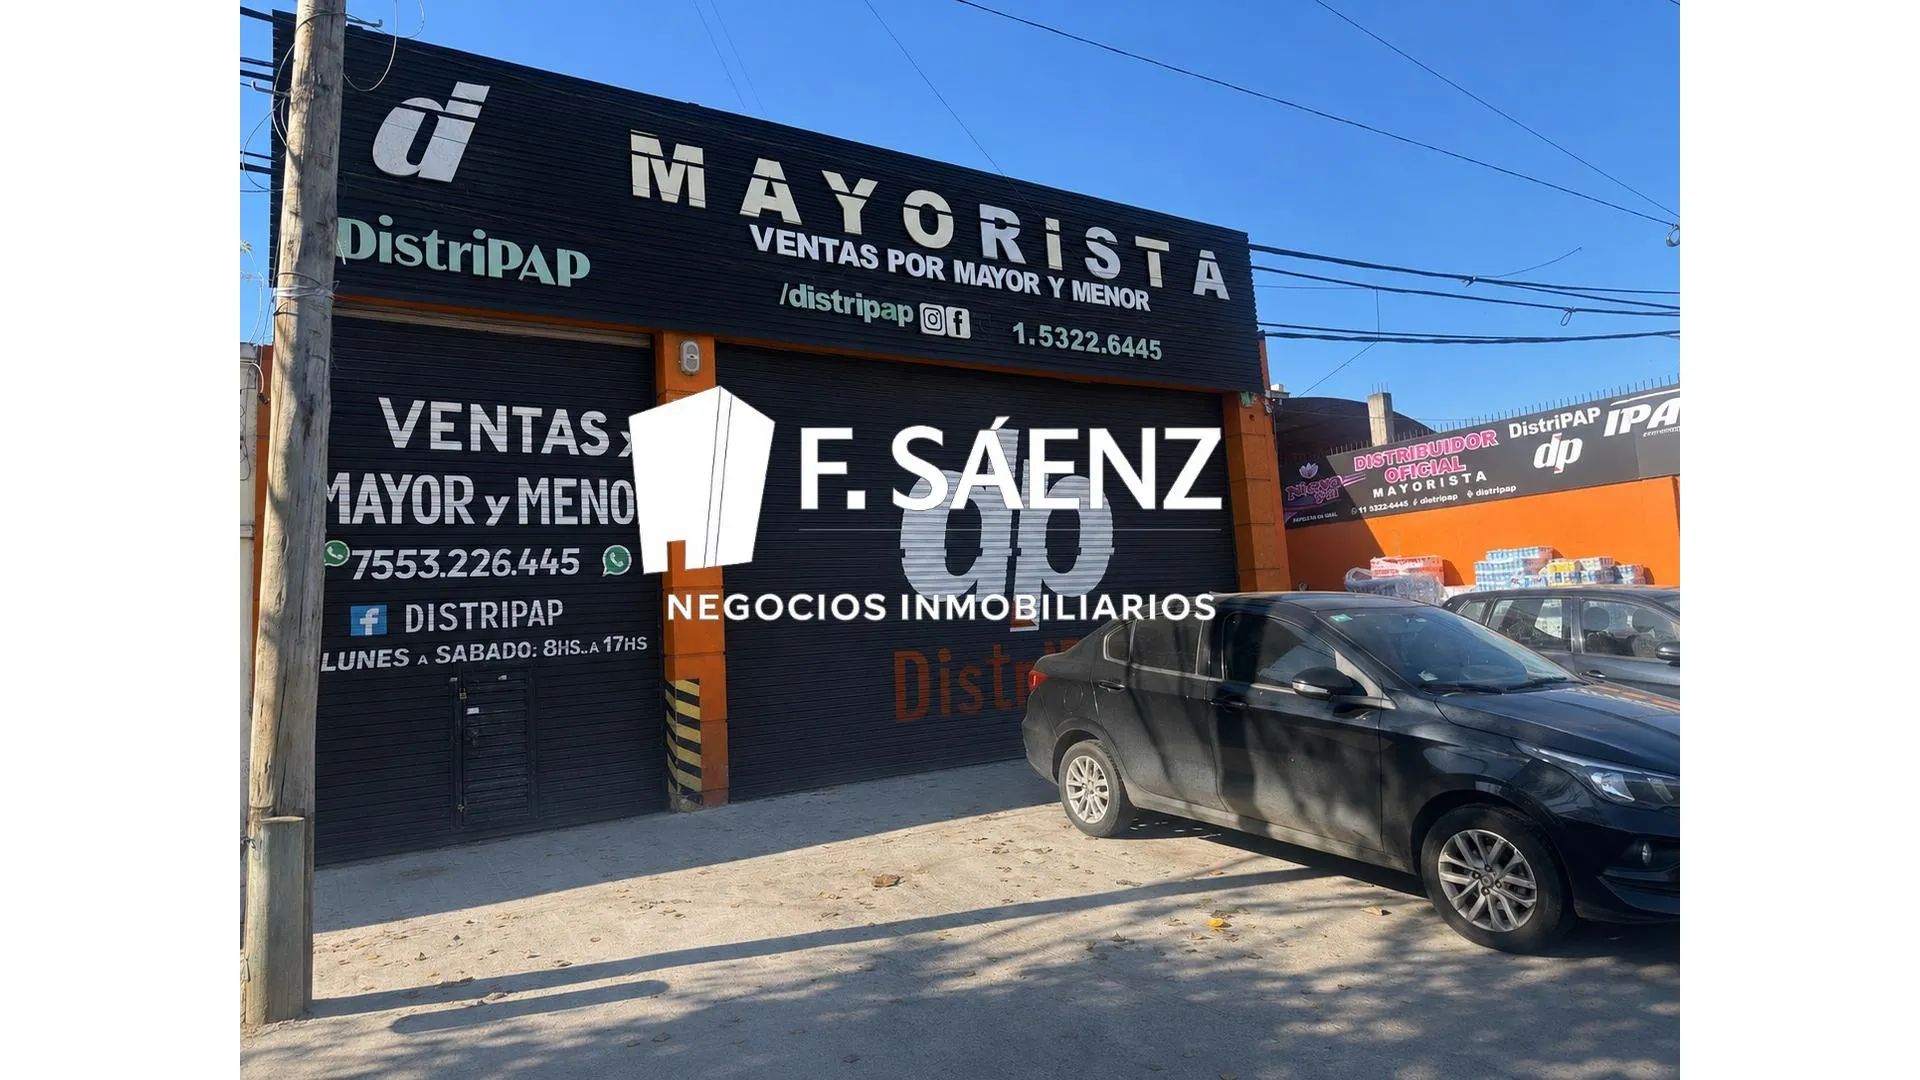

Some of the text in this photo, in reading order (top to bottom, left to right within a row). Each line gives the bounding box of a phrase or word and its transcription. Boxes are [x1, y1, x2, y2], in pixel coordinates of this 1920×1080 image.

[630, 129, 1230, 300] MAYORISTA
[337, 214, 591, 288] DistriPAP
[749, 224, 1151, 312] VENTAS POR MAYOR Y MENOR
[1012, 321, 1163, 361] 1.5322.6445
[378, 397, 611, 457] VENTAS
[1509, 407, 1600, 439] DistriPAP
[1354, 430, 1498, 471] DISTRIBUIDOR
[1385, 456, 1466, 484] OFICIAL
[326, 472, 475, 526] MAYOR
[517, 477, 635, 525] MENO
[1373, 471, 1487, 498] MAYORISTA
[351, 548, 580, 581] 7553.226.445
[405, 599, 564, 633] DISTRIPAP
[320, 648, 410, 672] LUNES
[417, 654, 428, 665] A
[435, 641, 538, 665] SABADO:
[603, 635, 648, 652] 17HS
